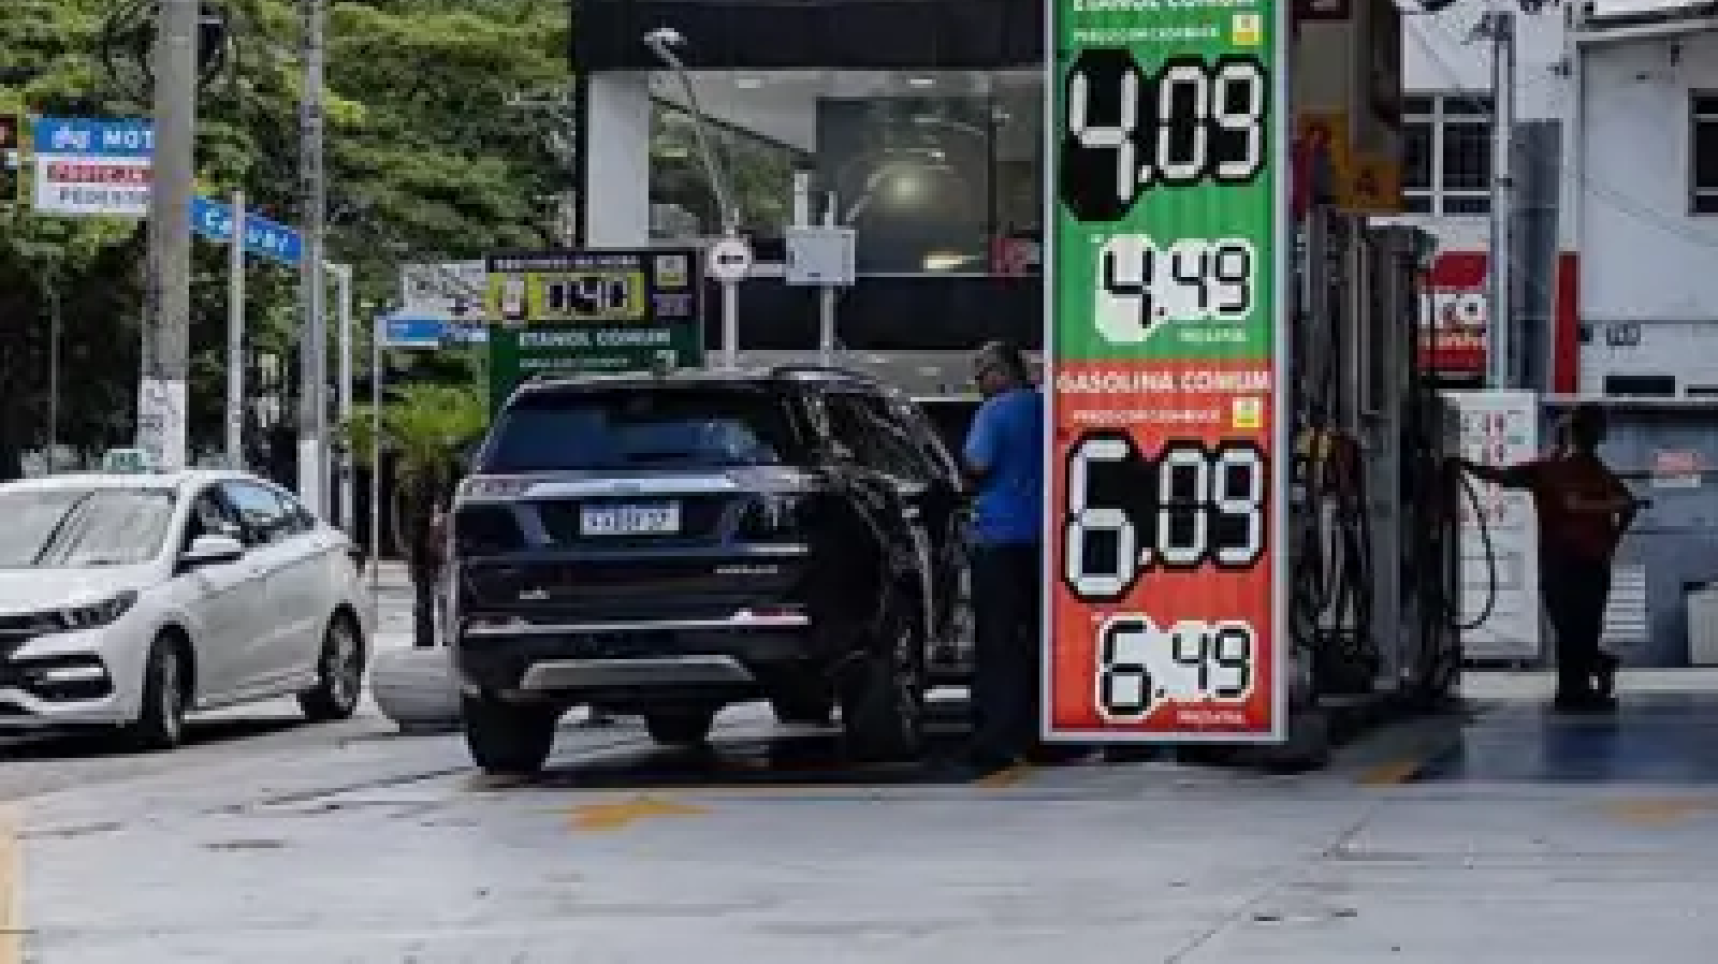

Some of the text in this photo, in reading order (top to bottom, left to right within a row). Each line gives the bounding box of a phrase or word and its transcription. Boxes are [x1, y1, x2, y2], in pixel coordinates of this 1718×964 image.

[103, 129, 154, 150] MOT
[1058, 369, 1271, 394] GASOLINA COMUM
